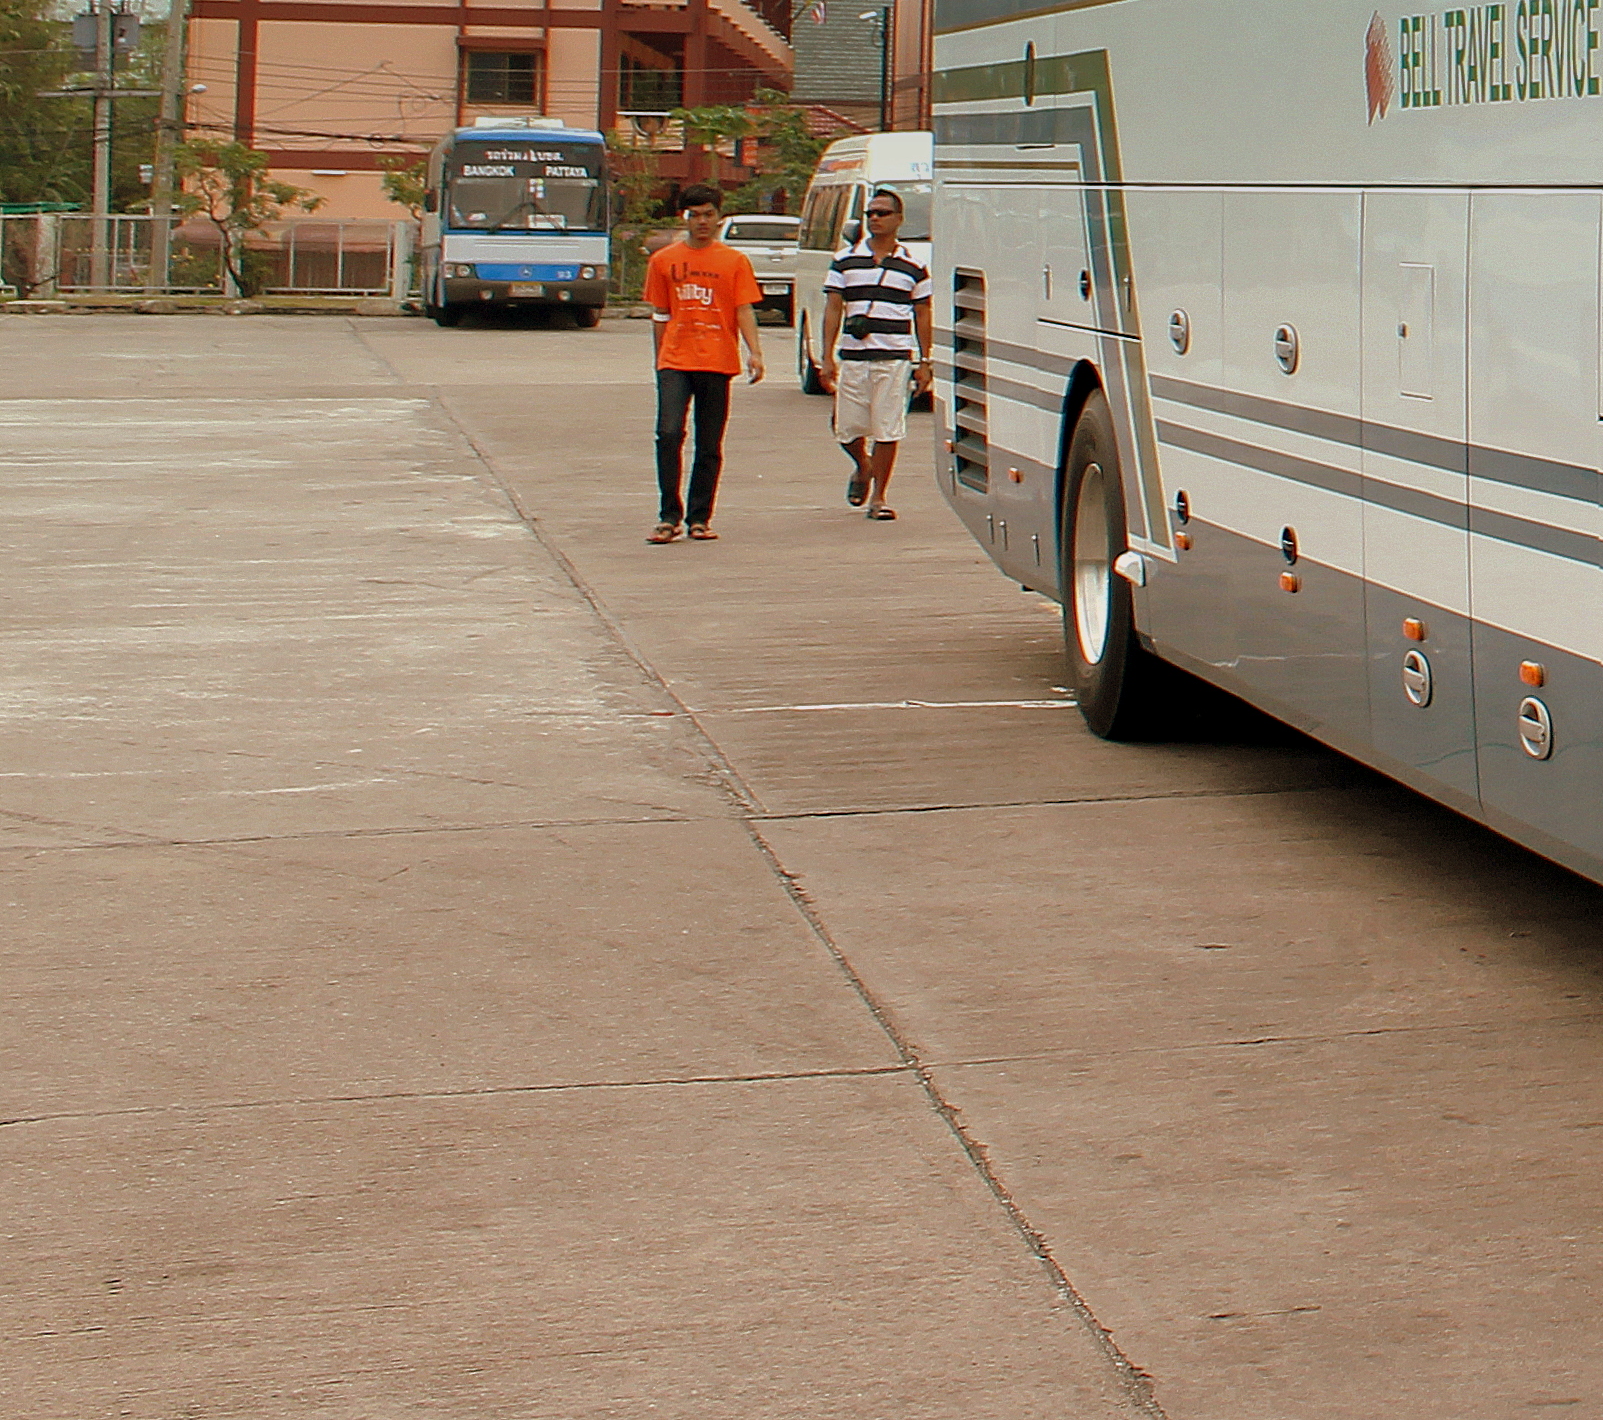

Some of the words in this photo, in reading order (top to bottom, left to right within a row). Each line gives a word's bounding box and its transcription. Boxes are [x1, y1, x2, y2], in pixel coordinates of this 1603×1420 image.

[1398, 14, 1443, 110] BELL
[1443, 2, 1513, 106] TRAVEL
[462, 165, 515, 177] BANGKOK
[545, 165, 588, 178] PATTAYA
